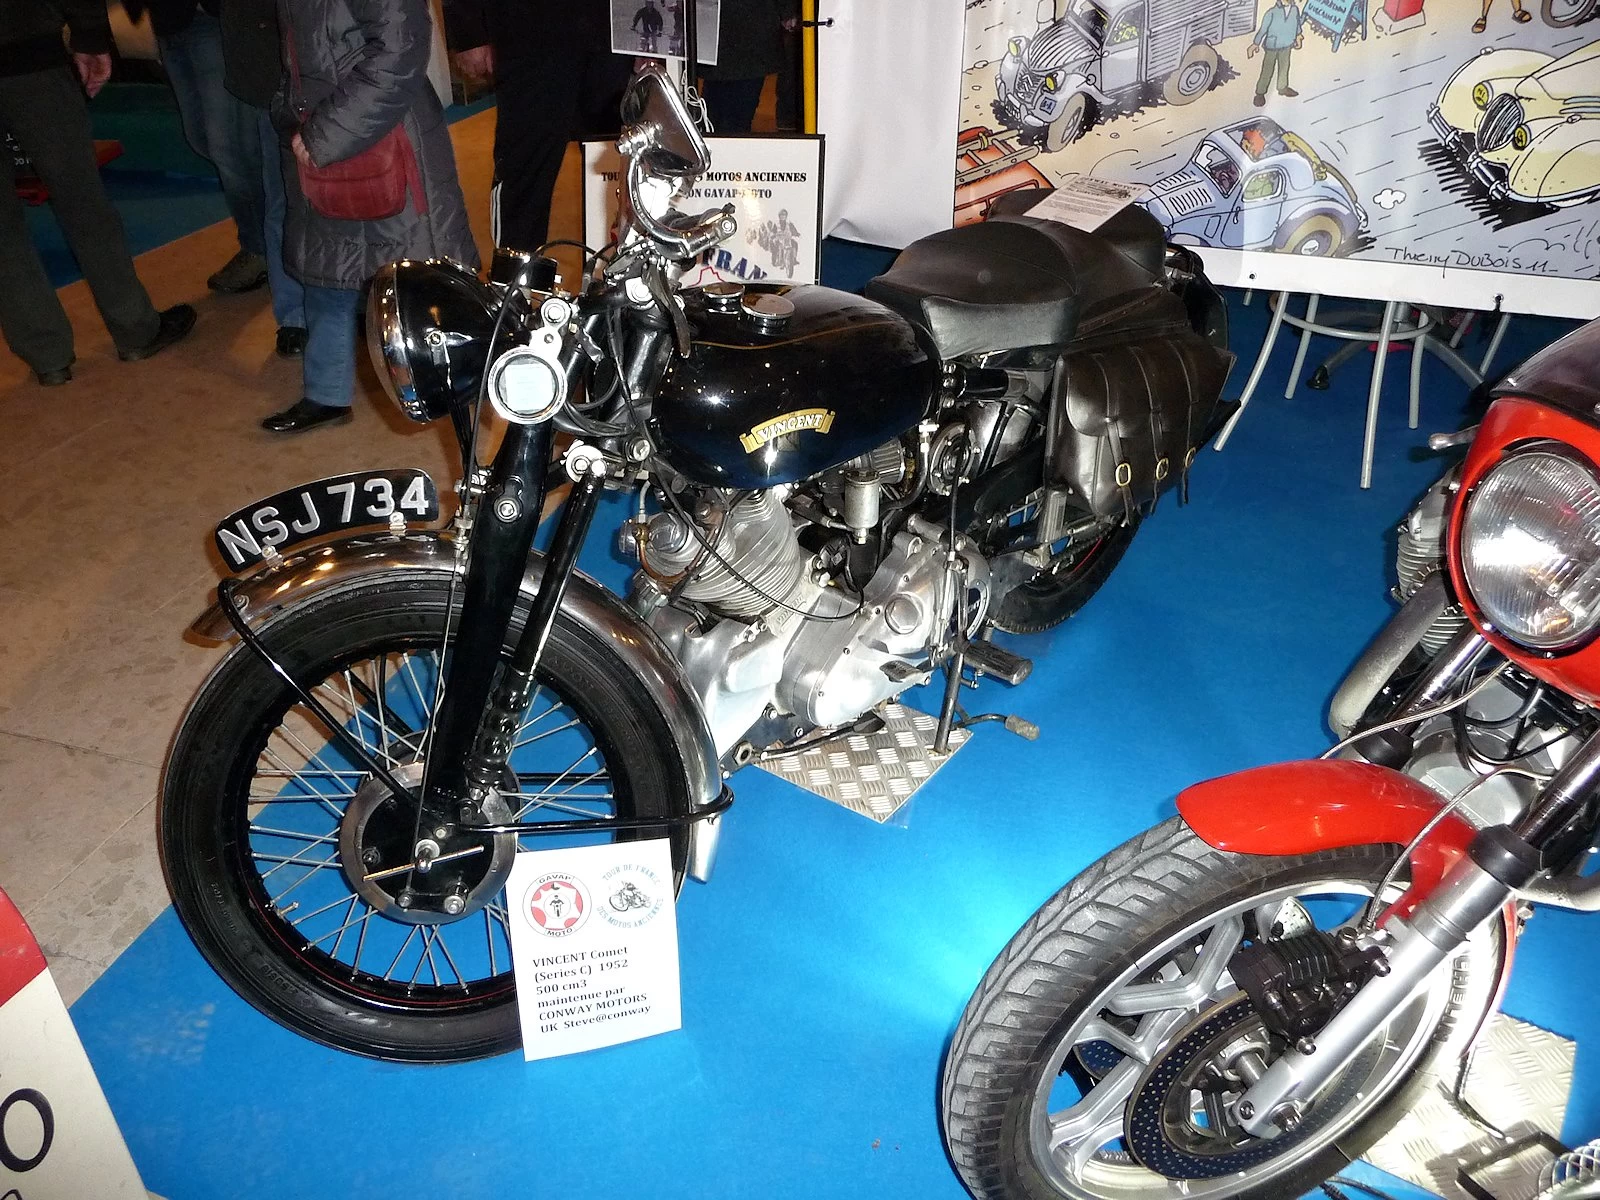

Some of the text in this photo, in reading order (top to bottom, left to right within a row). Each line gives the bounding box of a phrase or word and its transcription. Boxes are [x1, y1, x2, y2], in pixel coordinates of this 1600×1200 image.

[601, 172, 620, 182] TOU
[706, 172, 742, 182] MOTOS
[744, 172, 807, 182] ANCIENNES
[757, 414, 823, 440] VINCENT
[218, 476, 429, 565] NSJ 734
[539, 874, 572, 884] GAVAP
[602, 866, 620, 880] TOUR
[547, 928, 573, 937] MOTO
[607, 916, 632, 928] MOTOS
[532, 946, 628, 968] VINCENT Comet
[535, 959, 629, 983] (Series C) 1952
[536, 979, 587, 995] 500 cm3
[538, 986, 625, 1008] maintenue par
[539, 993, 647, 1021] CONWAY MOTORS
[540, 1005, 651, 1033] UK Steve@conway
